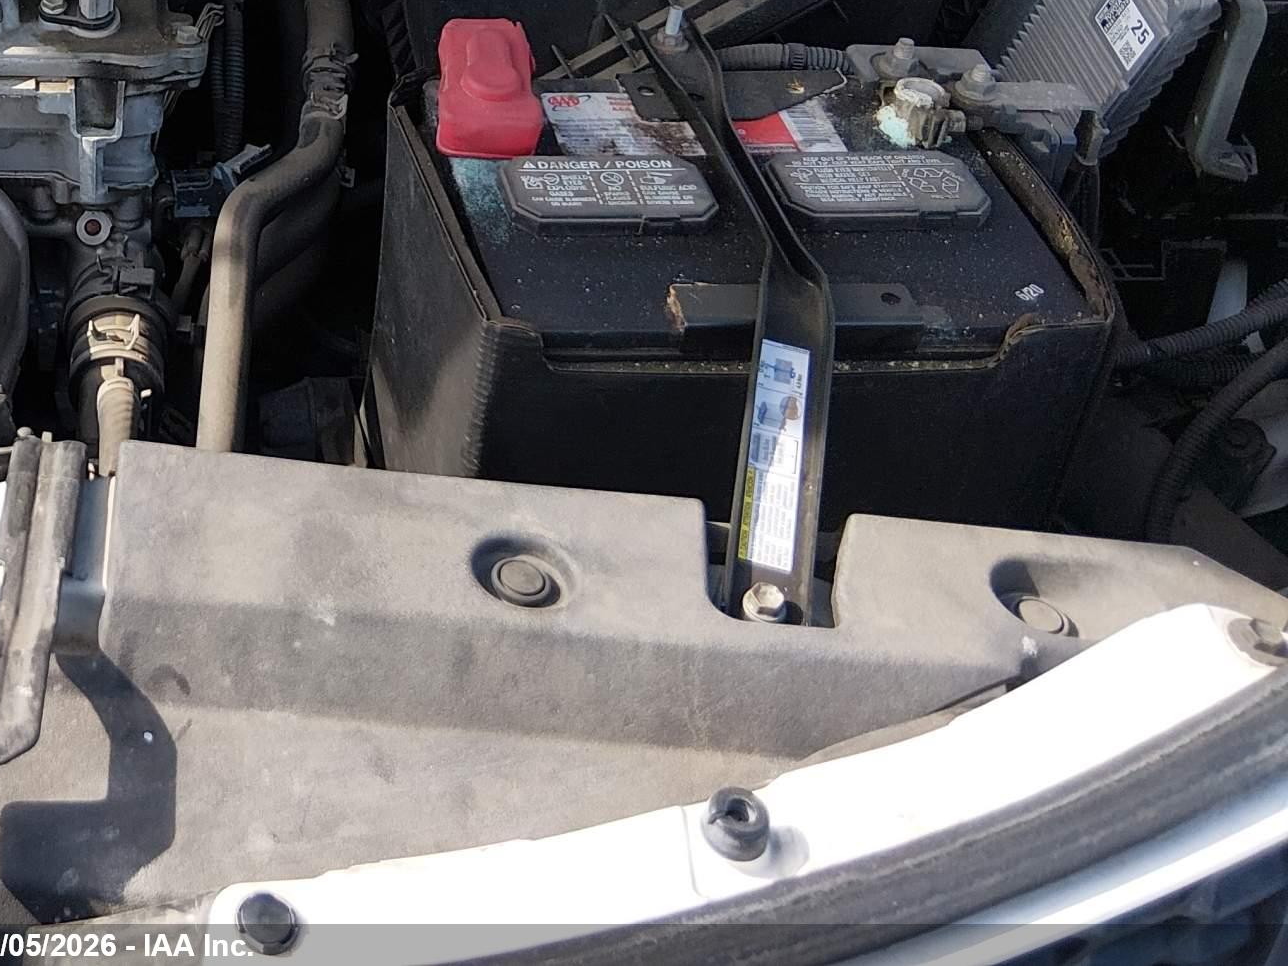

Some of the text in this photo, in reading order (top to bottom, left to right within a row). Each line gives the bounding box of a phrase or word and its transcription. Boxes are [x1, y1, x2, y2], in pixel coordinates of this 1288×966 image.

[1131, 18, 1150, 45] 25
[537, 160, 600, 170] DANGER
[615, 159, 672, 169] POISON
